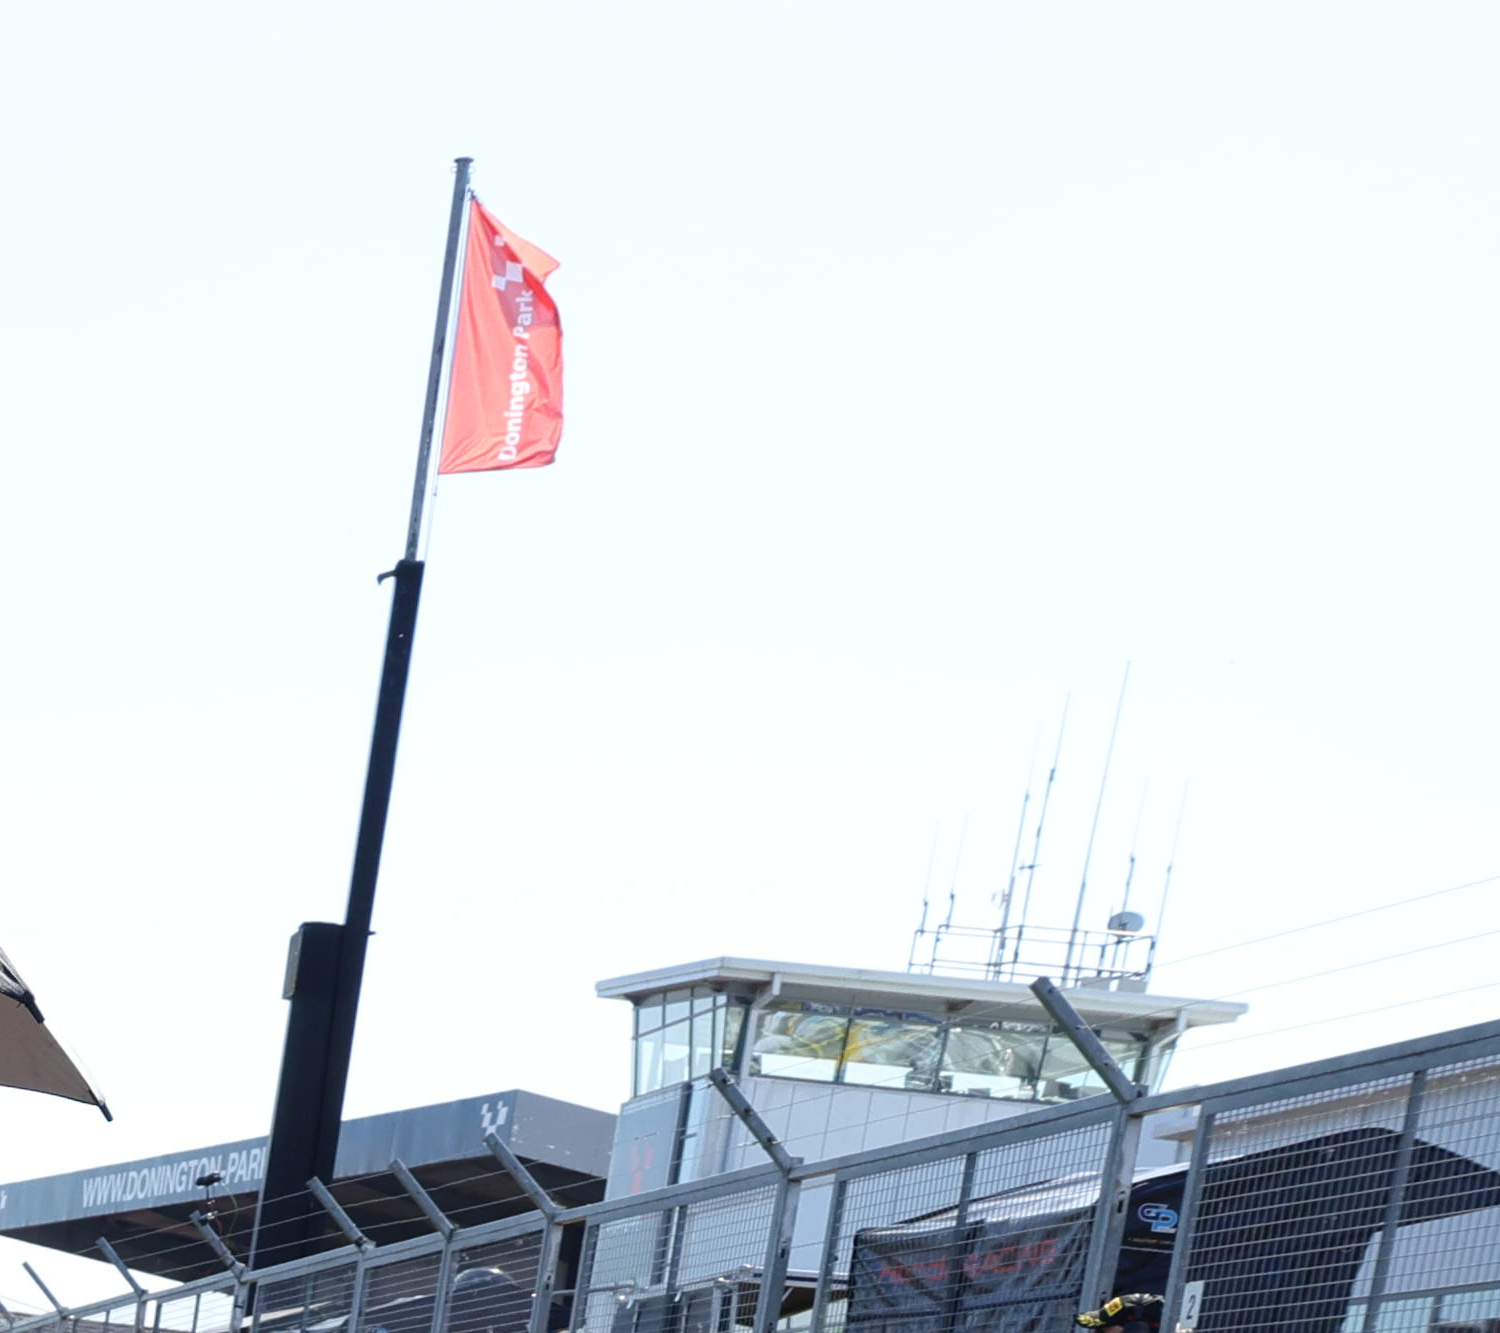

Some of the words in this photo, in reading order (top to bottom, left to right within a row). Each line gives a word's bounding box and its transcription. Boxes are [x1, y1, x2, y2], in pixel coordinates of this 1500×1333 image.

[513, 287, 534, 340] Park
[498, 340, 530, 461] Donington
[82, 1146, 268, 1209] WWW.DONINGTON-PAR
